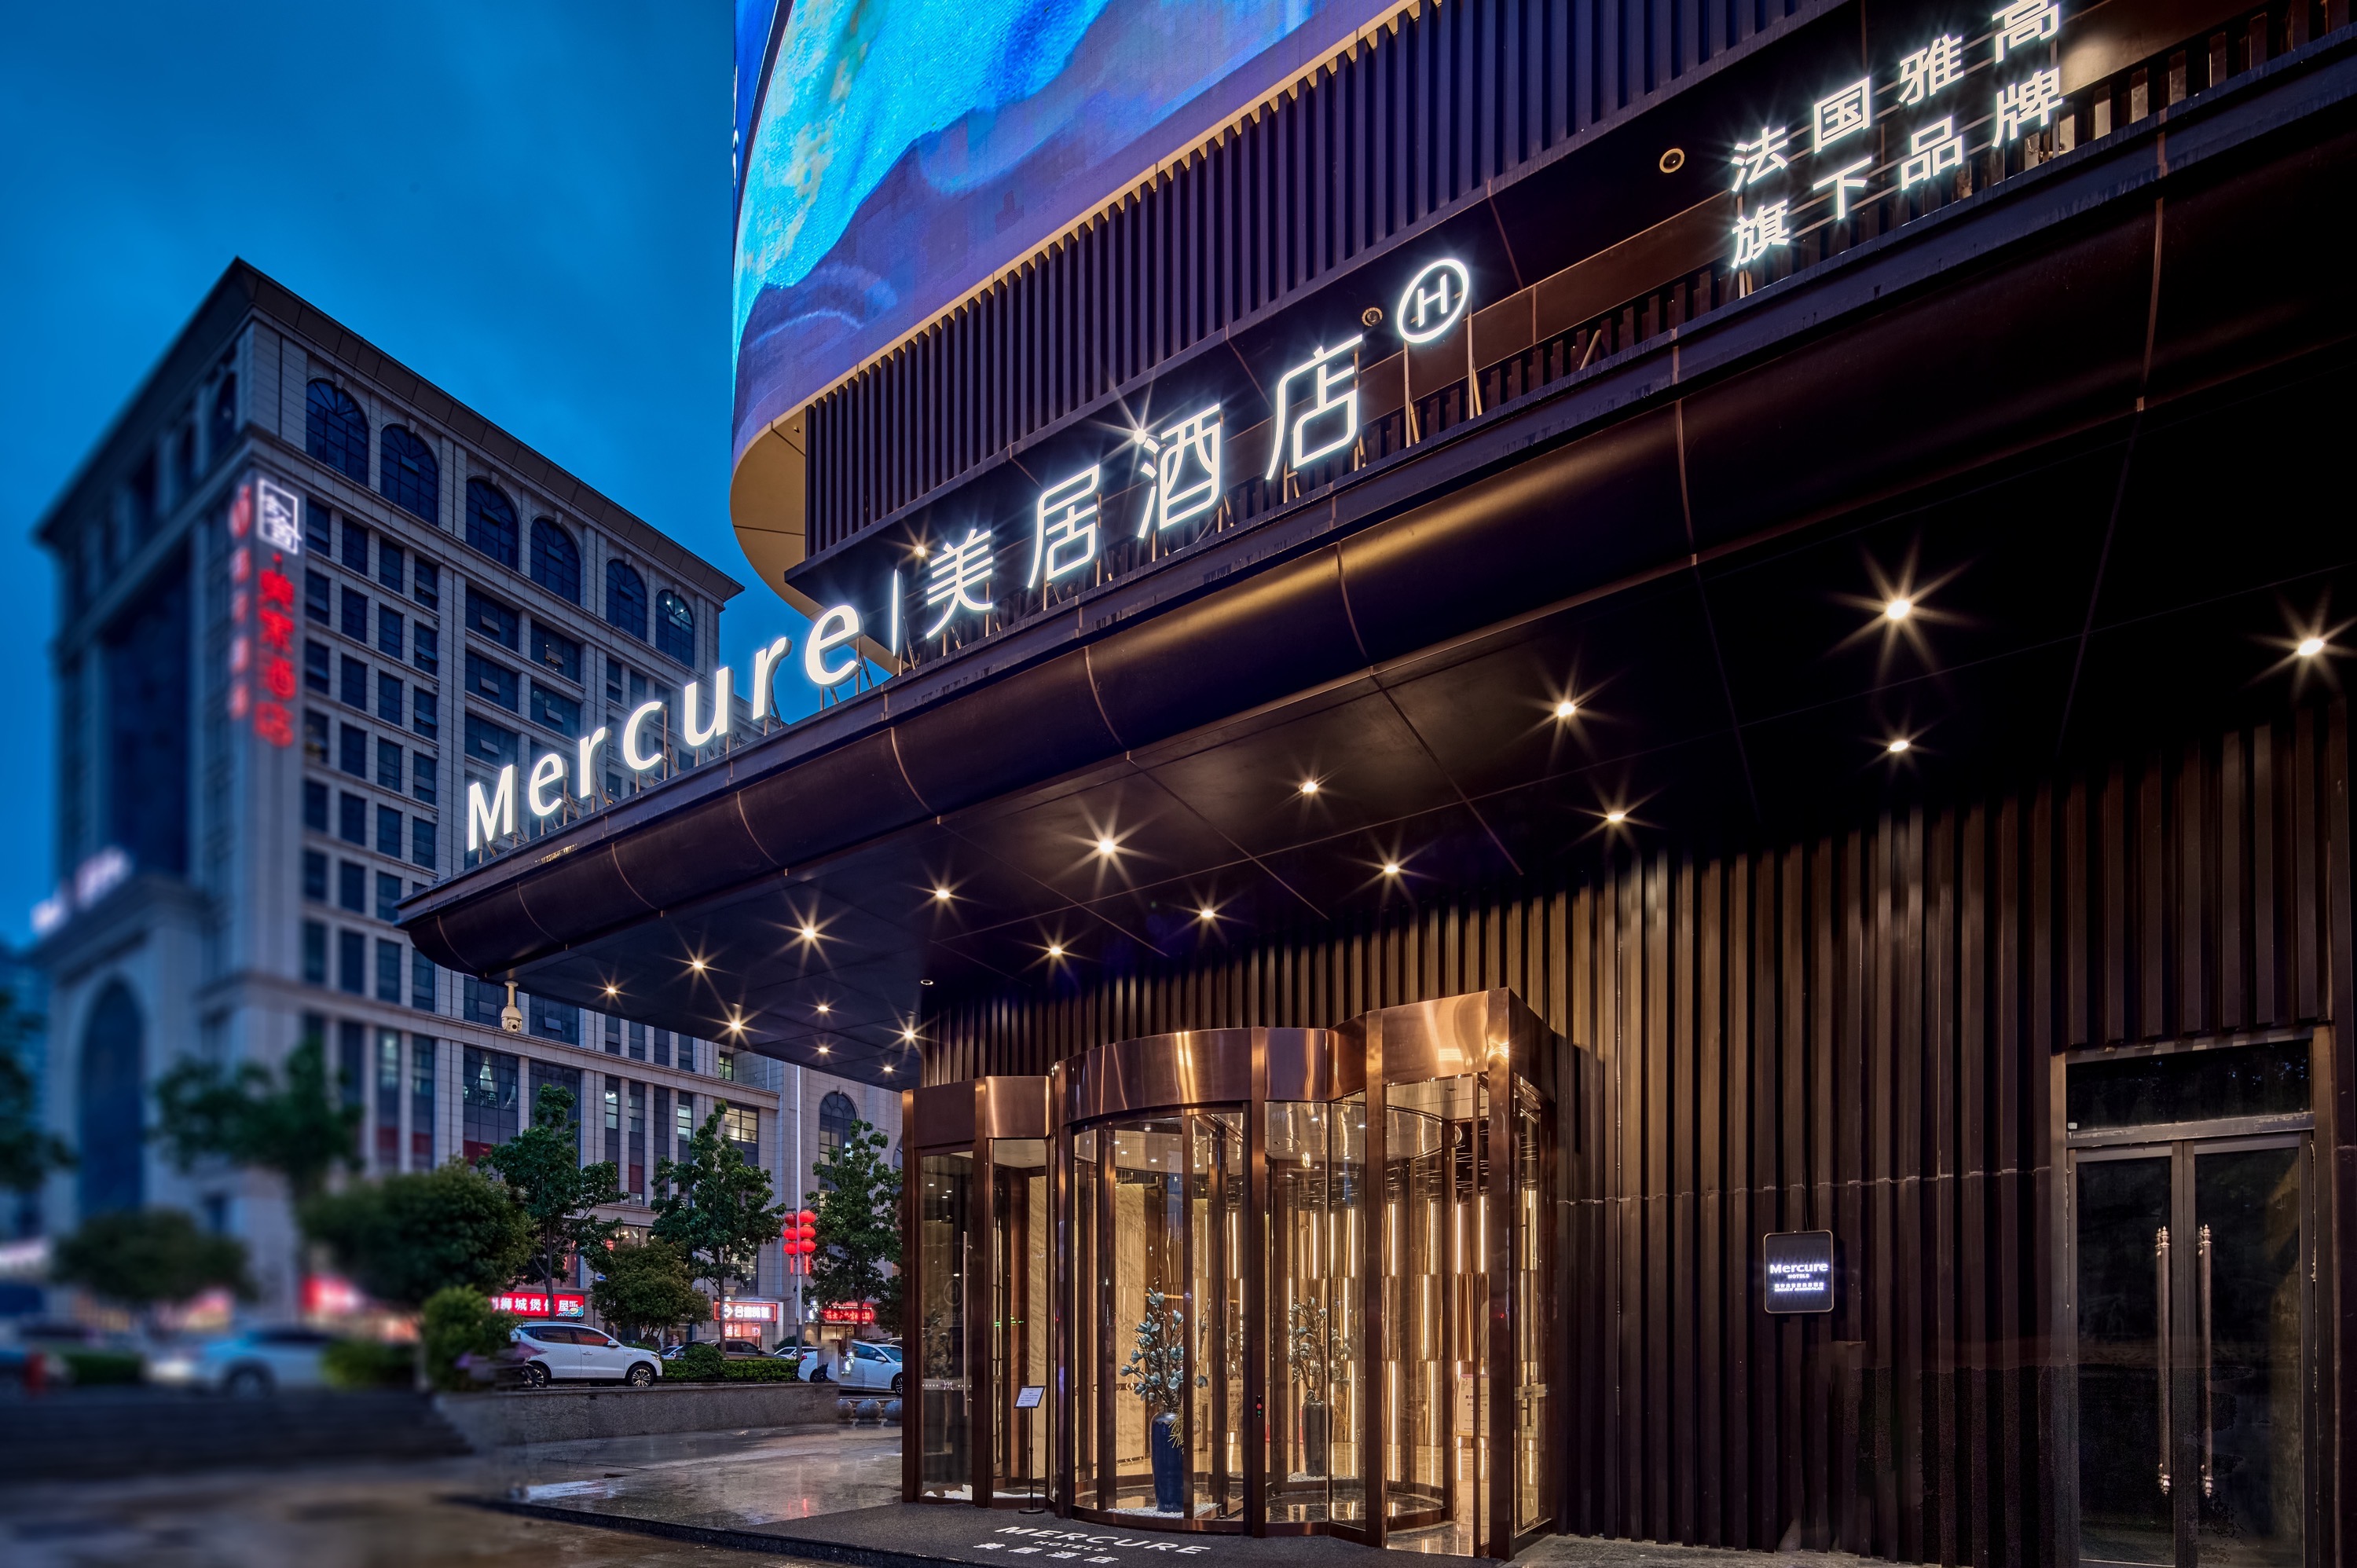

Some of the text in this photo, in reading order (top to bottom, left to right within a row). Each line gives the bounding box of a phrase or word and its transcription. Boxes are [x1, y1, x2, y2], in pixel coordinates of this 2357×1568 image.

[1731, 0, 2059, 192] 法国雅高
[1732, 68, 2063, 269] 旗下品牌
[926, 334, 1362, 639] 美居酒店
[468, 604, 863, 852] Mercure
[1769, 1263, 1829, 1274] Mercure
[973, 1542, 1119, 1564] 美居酒店
[995, 1526, 1211, 1555] MERCURE
[1033, 1541, 1108, 1552] HOTELS
